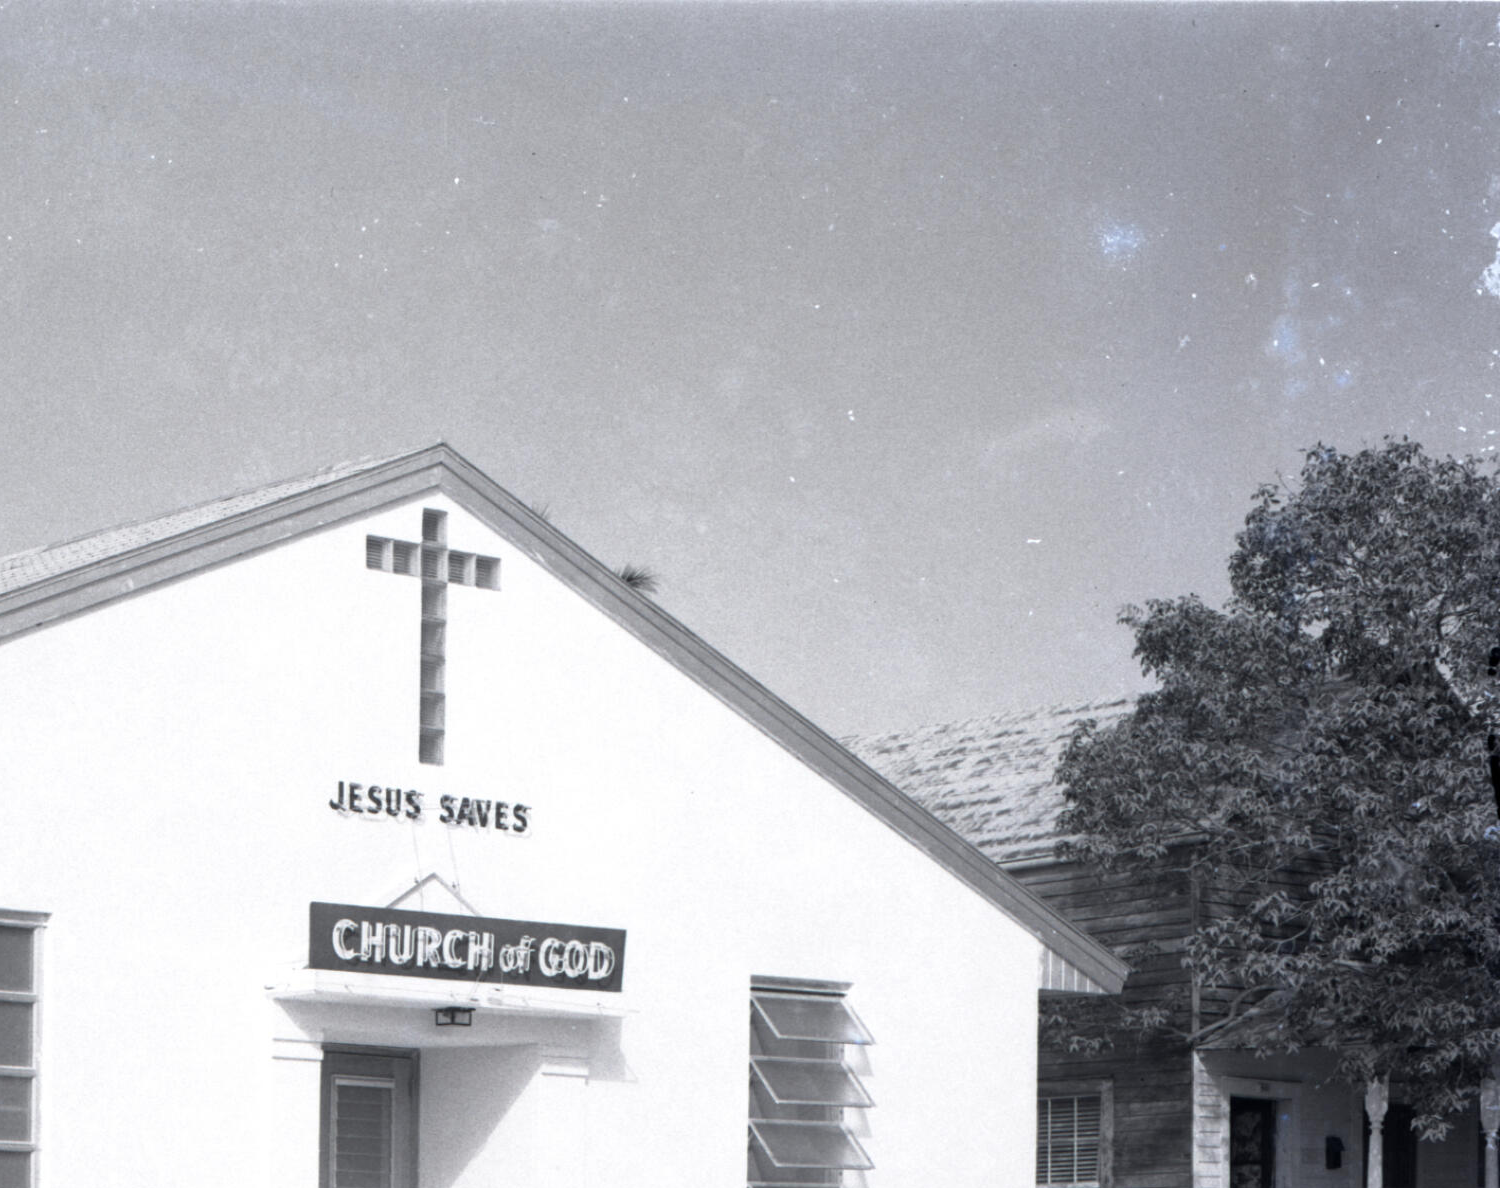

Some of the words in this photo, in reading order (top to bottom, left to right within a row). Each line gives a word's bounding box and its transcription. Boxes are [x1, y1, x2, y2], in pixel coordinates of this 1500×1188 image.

[329, 781, 423, 820] JESUS
[439, 794, 532, 834] SAVES
[332, 918, 496, 972] CHURCH
[499, 935, 536, 974] of
[538, 936, 616, 981] GOD
